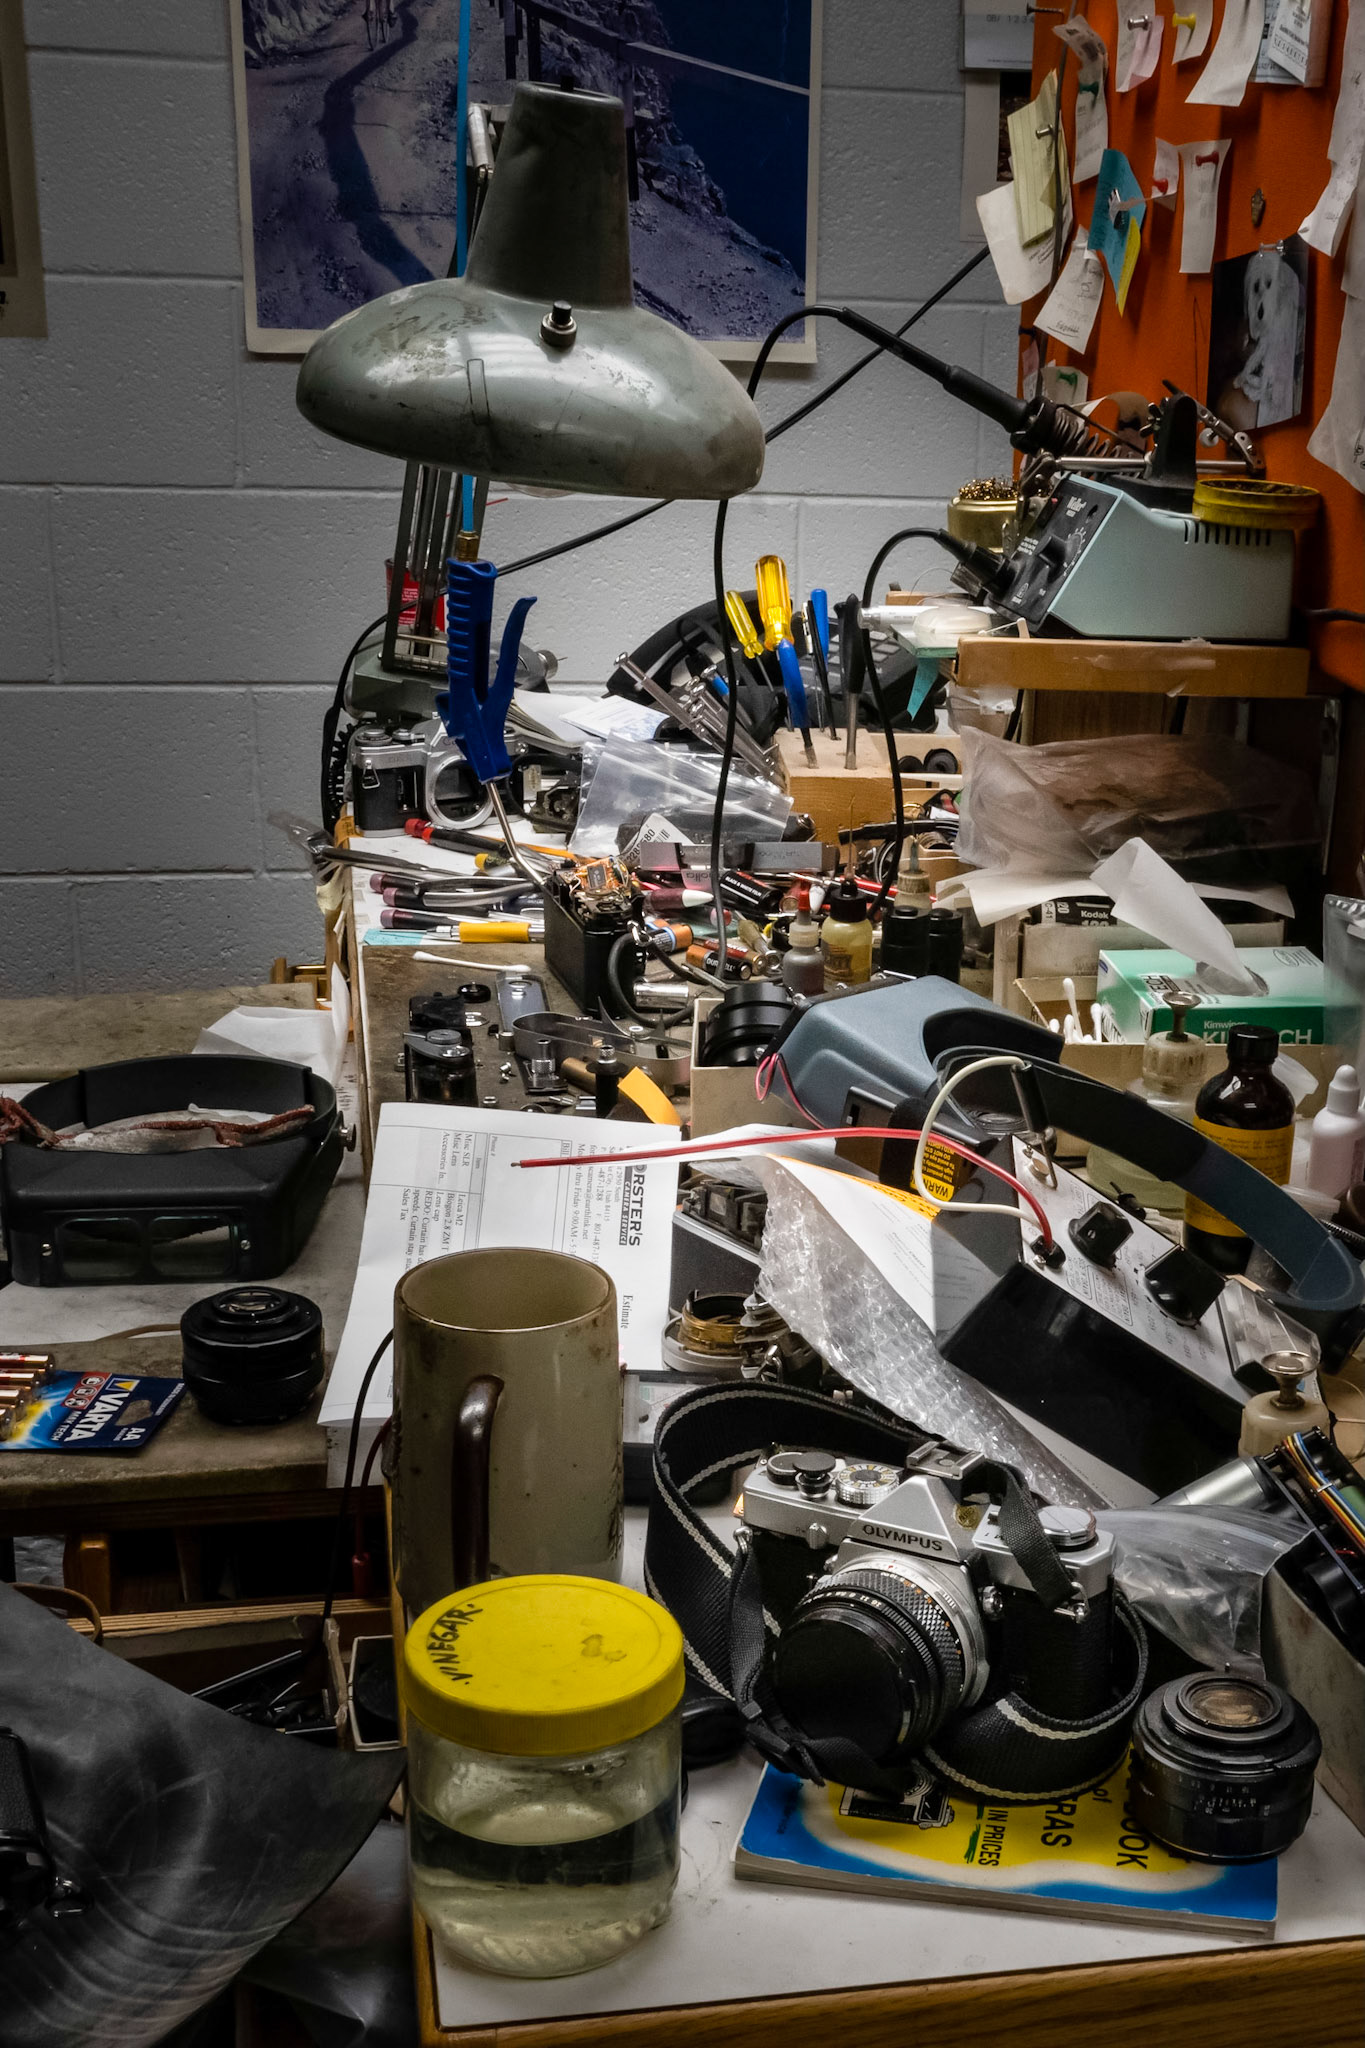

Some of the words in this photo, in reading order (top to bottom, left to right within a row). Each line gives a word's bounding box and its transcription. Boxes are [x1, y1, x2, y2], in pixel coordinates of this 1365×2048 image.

[1044, 903, 1053, 919] C-41
[1080, 909, 1109, 920] Kodak
[452, 1133, 462, 1150] Misc
[464, 1134, 473, 1150] Misc
[562, 1142, 570, 1156] Bill
[439, 1131, 451, 1170] Accessories
[450, 1151, 459, 1167] Lens
[461, 1152, 471, 1167] SLR
[575, 1172, 583, 1186] thru
[400, 1188, 411, 1207] Sales
[410, 1189, 421, 1214] speeds.
[422, 1190, 433, 1216] REDO:
[434, 1191, 444, 1208] Lens
[456, 1194, 466, 1213] Leica
[572, 1187, 582, 1208] Friday
[622, 1181, 631, 1212] CAMERA
[443, 1193, 455, 1218] Biogon
[399, 1208, 408, 1221] Tax
[432, 1209, 440, 1222] cap
[455, 1213, 463, 1226] M2
[408, 1215, 419, 1242] Curtain
[419, 1217, 430, 1243] Curtain
[443, 1219, 452, 1230] 2.8
[570, 1210, 580, 1238] 9:00AM
[619, 1214, 628, 1245] SERVICE
[442, 1231, 450, 1244] ZM
[405, 1243, 415, 1257] stay
[418, 1245, 427, 1256] has
[620, 1294, 634, 1329] Estimate
[63, 1392, 131, 1442] VARTA
[50, 1424, 70, 1441] TECH
[122, 1427, 147, 1441] AA
[862, 1524, 944, 1553] OLYMPUS
[1091, 1788, 1112, 1803] of
[987, 1809, 1009, 1822] IN
[977, 1824, 1006, 1867] PRICES
